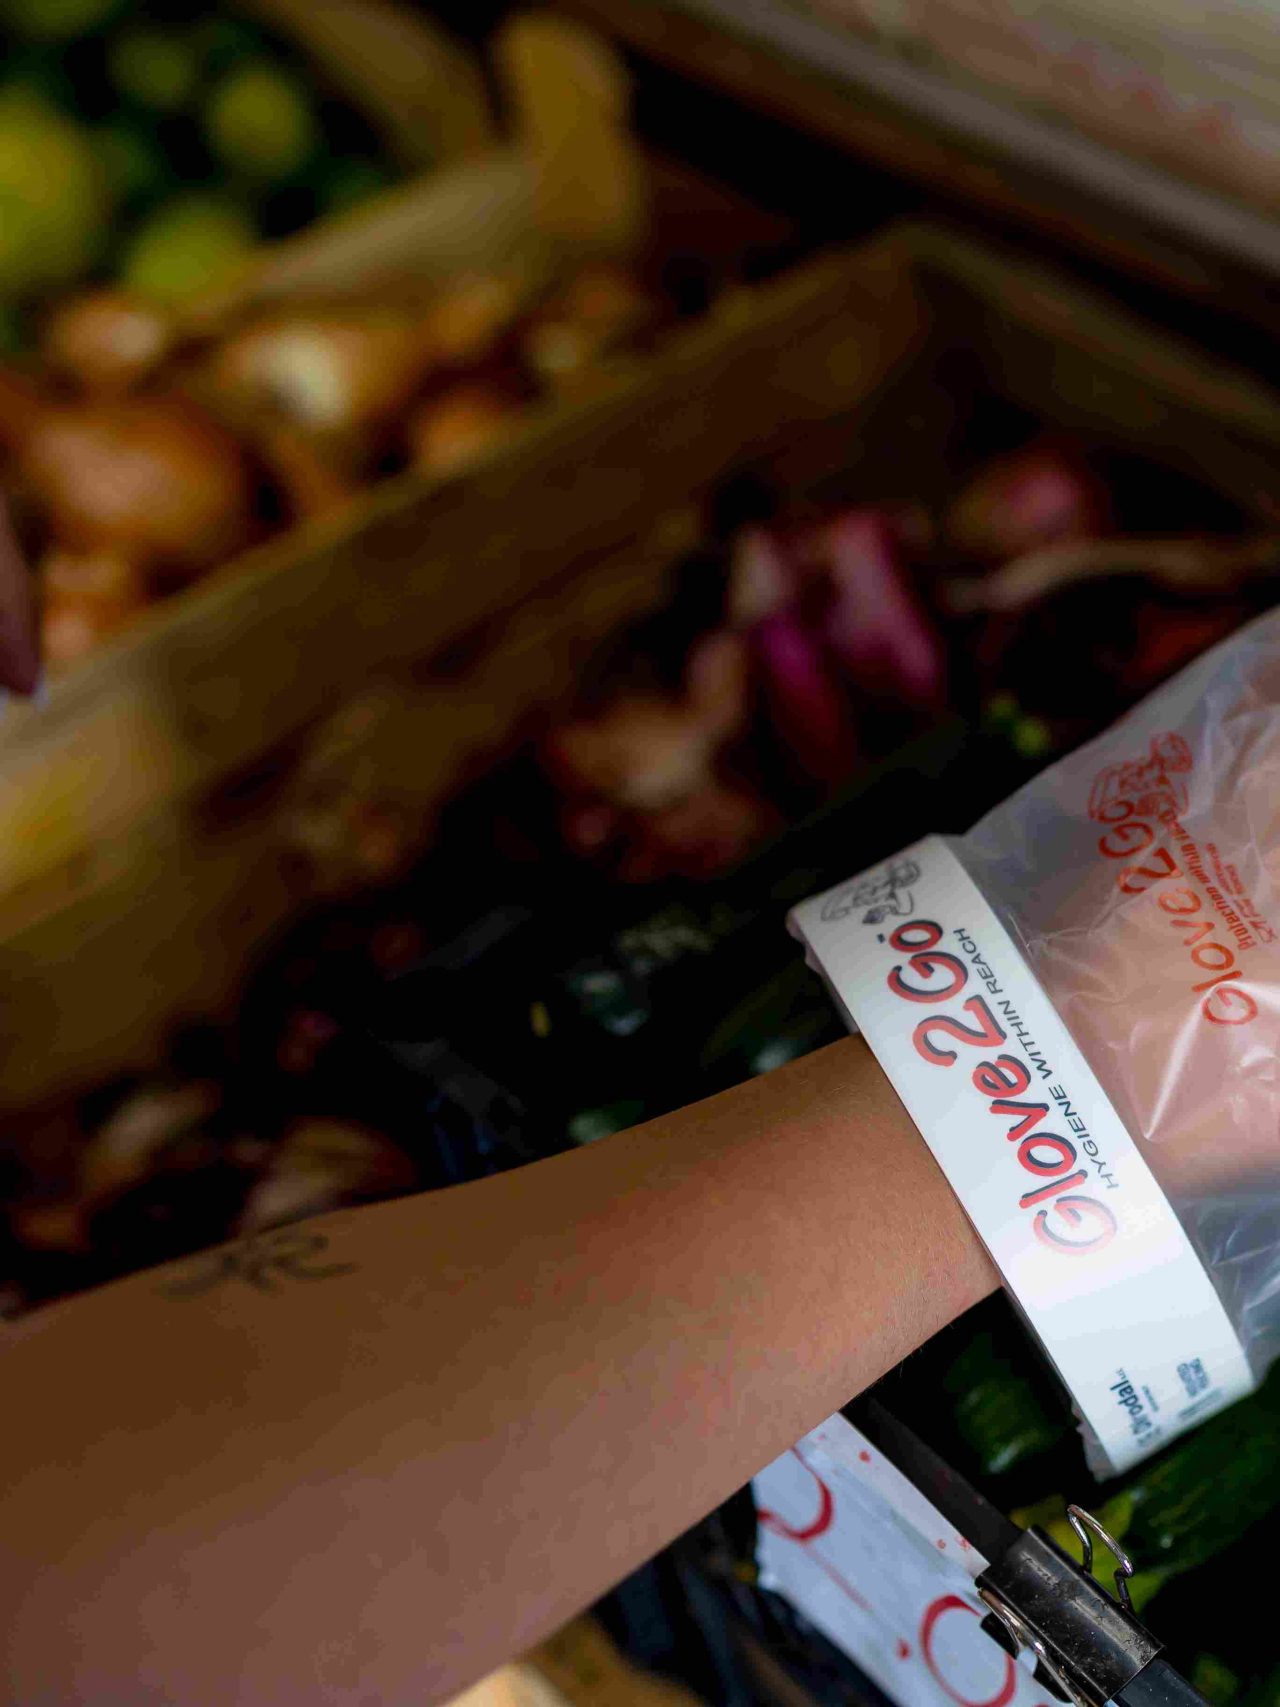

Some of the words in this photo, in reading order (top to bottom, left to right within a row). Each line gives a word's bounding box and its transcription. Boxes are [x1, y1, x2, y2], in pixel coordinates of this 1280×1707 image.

[1205, 886, 1257, 951] Protection
[953, 927, 1004, 995] REACH
[997, 1000, 1053, 1080] WITHIN
[887, 918, 1118, 1257] Glove2Go
[1048, 1084, 1119, 1189] HYGIENE
